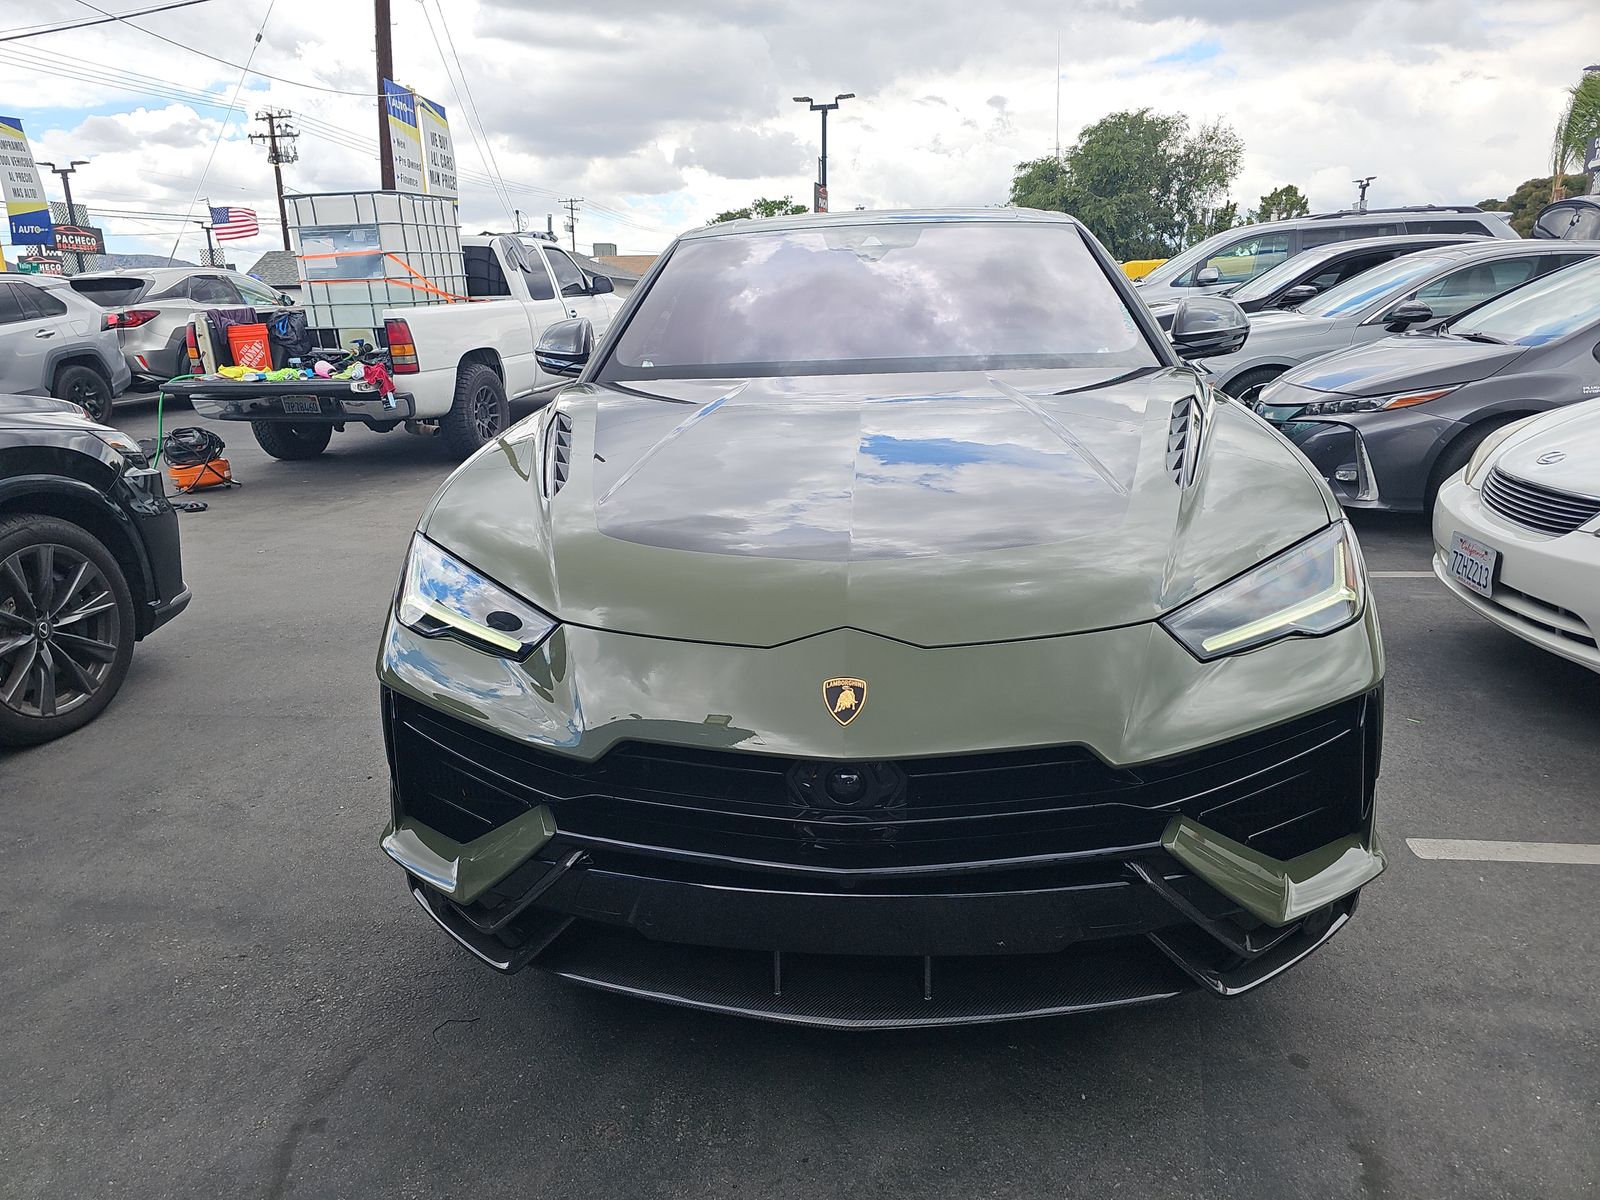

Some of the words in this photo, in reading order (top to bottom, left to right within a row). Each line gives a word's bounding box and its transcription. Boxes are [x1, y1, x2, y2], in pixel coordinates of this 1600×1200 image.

[392, 97, 408, 113] AUTO
[430, 131, 439, 148] WE
[438, 133, 449, 151] BUY
[10, 156, 34, 168] VEHICULO
[430, 150, 440, 167] ALL
[440, 153, 454, 171] CARS
[8, 171, 15, 182] AL
[15, 172, 33, 183] PRECIO
[400, 173, 419, 188] Finance
[429, 169, 441, 187] MAX
[18, 225, 40, 235] AUTO
[55, 234, 97, 246] PACHECO
[40, 263, 61, 271] HECO
[240, 343, 250, 355] THE
[240, 340, 263, 367] HOME
[250, 350, 265, 368] DEPOT
[1461, 539, 1488, 561] California
[1451, 550, 1490, 589] 7ZHZ213
[826, 680, 864, 689] LAMBORGHINI
